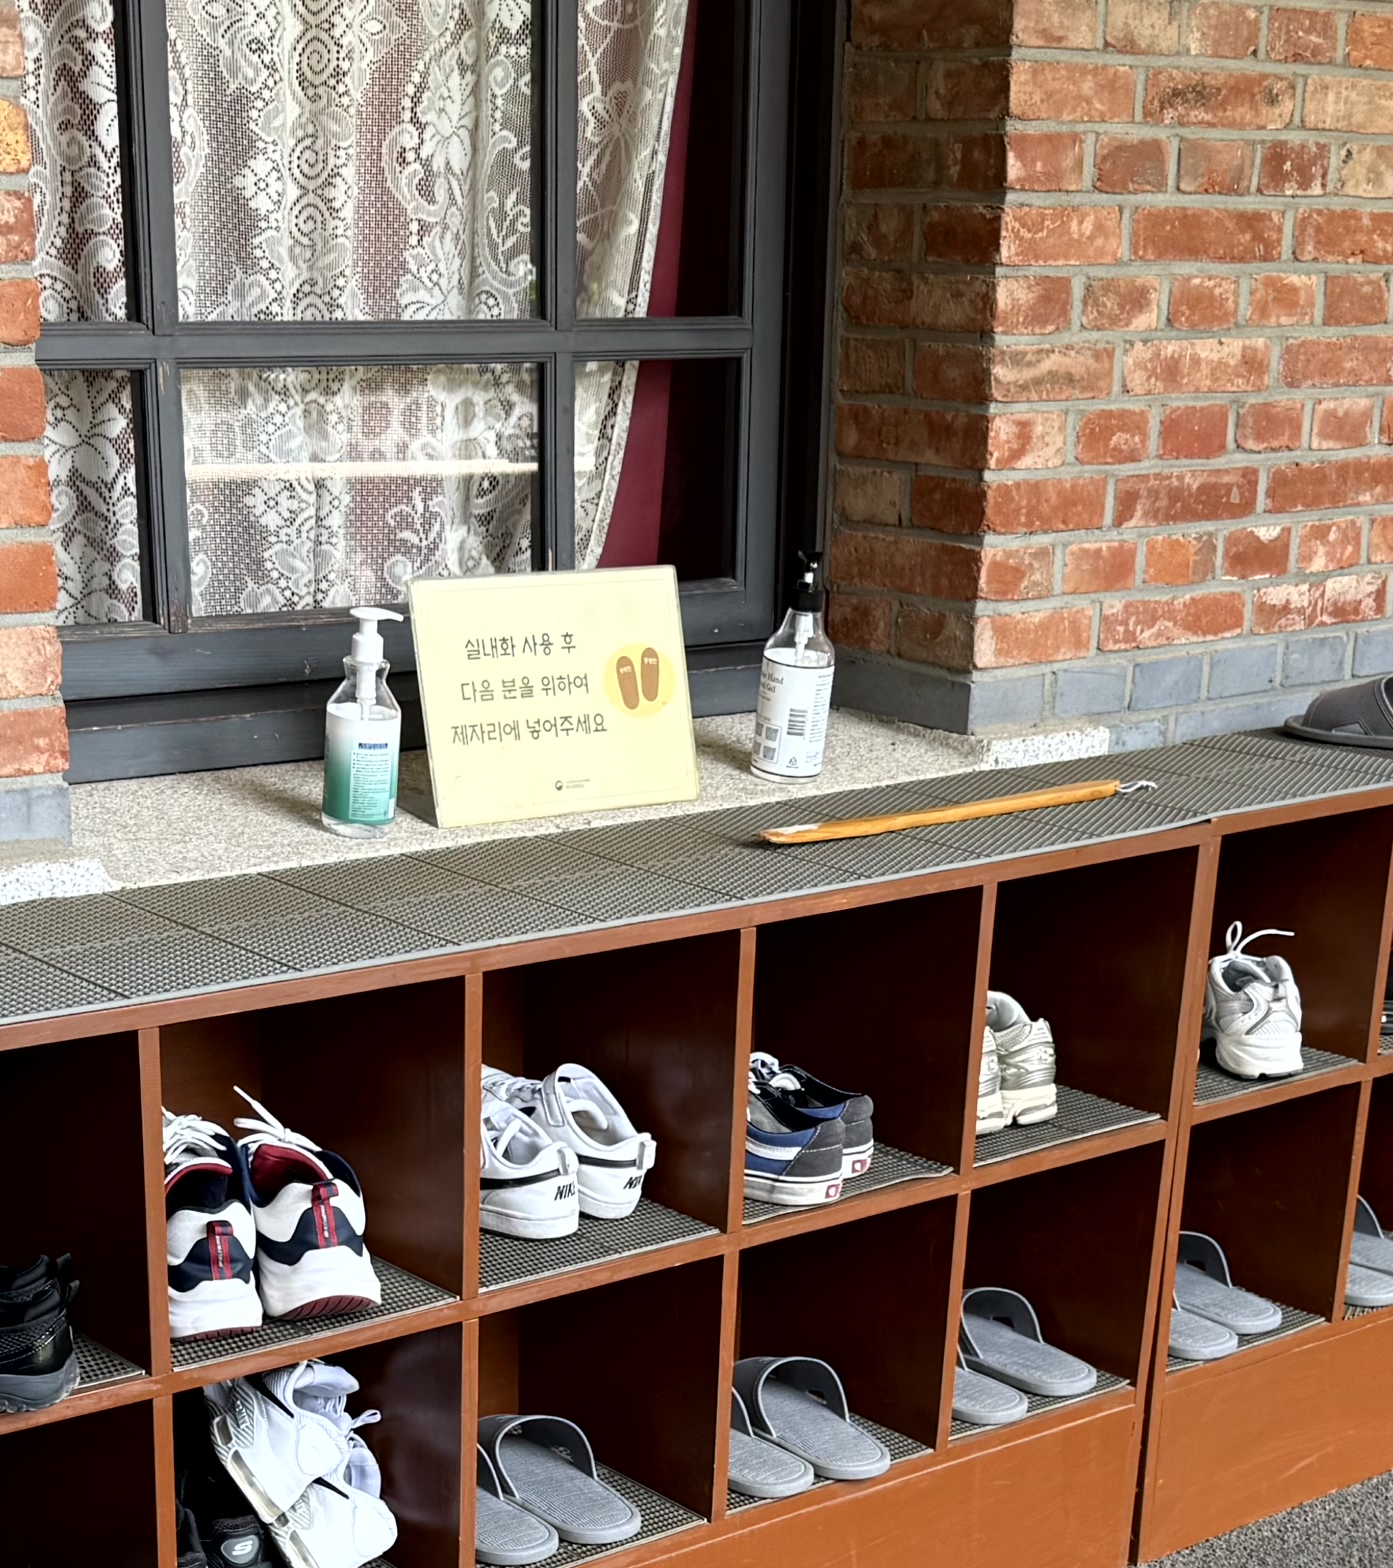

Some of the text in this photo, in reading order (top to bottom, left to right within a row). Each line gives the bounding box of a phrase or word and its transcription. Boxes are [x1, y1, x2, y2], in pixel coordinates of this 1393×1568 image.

[465, 632, 576, 660] 실내화 사용 후
[460, 673, 589, 703] 다음 분을 위하여
[451, 713, 608, 746] 제자리에 넣어주세요
